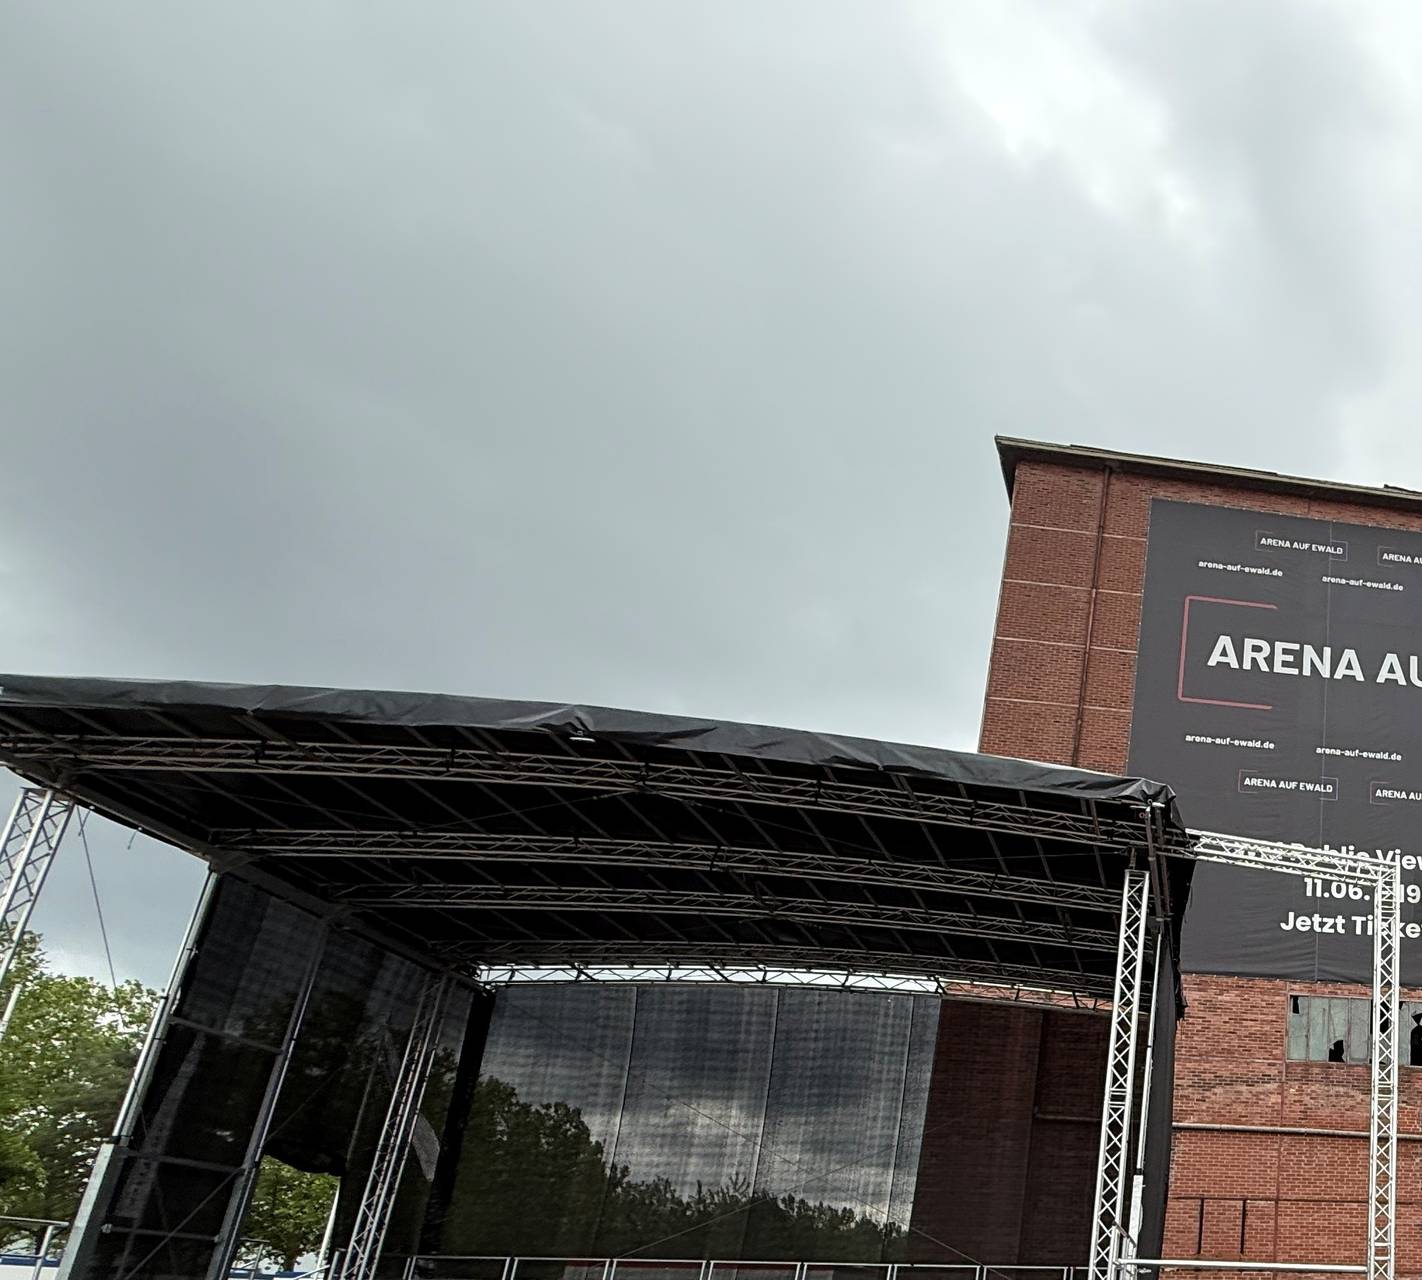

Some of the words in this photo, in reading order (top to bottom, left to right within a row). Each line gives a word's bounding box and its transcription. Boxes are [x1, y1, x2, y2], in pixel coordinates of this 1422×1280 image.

[1260, 537, 1291, 548] ARENA
[1292, 542, 1310, 550] AUF
[1312, 544, 1343, 555] EWALD
[1382, 552, 1412, 563] ARENA
[1198, 560, 1283, 577] arena-auf-ewald.de
[1322, 575, 1403, 591] arena-auf-ewald.de
[1207, 635, 1365, 682] ARENA
[1185, 733, 1275, 750] arena-auf-ewald.de
[1316, 746, 1402, 761] arena-auf-ewald.de
[1243, 777, 1277, 788] ARENA
[1278, 780, 1298, 790] AUF
[1299, 782, 1333, 793] EWALD
[1375, 789, 1407, 800] ARENA
[1304, 877, 1371, 901] 11.06.
[1280, 911, 1345, 934] Jetzt
